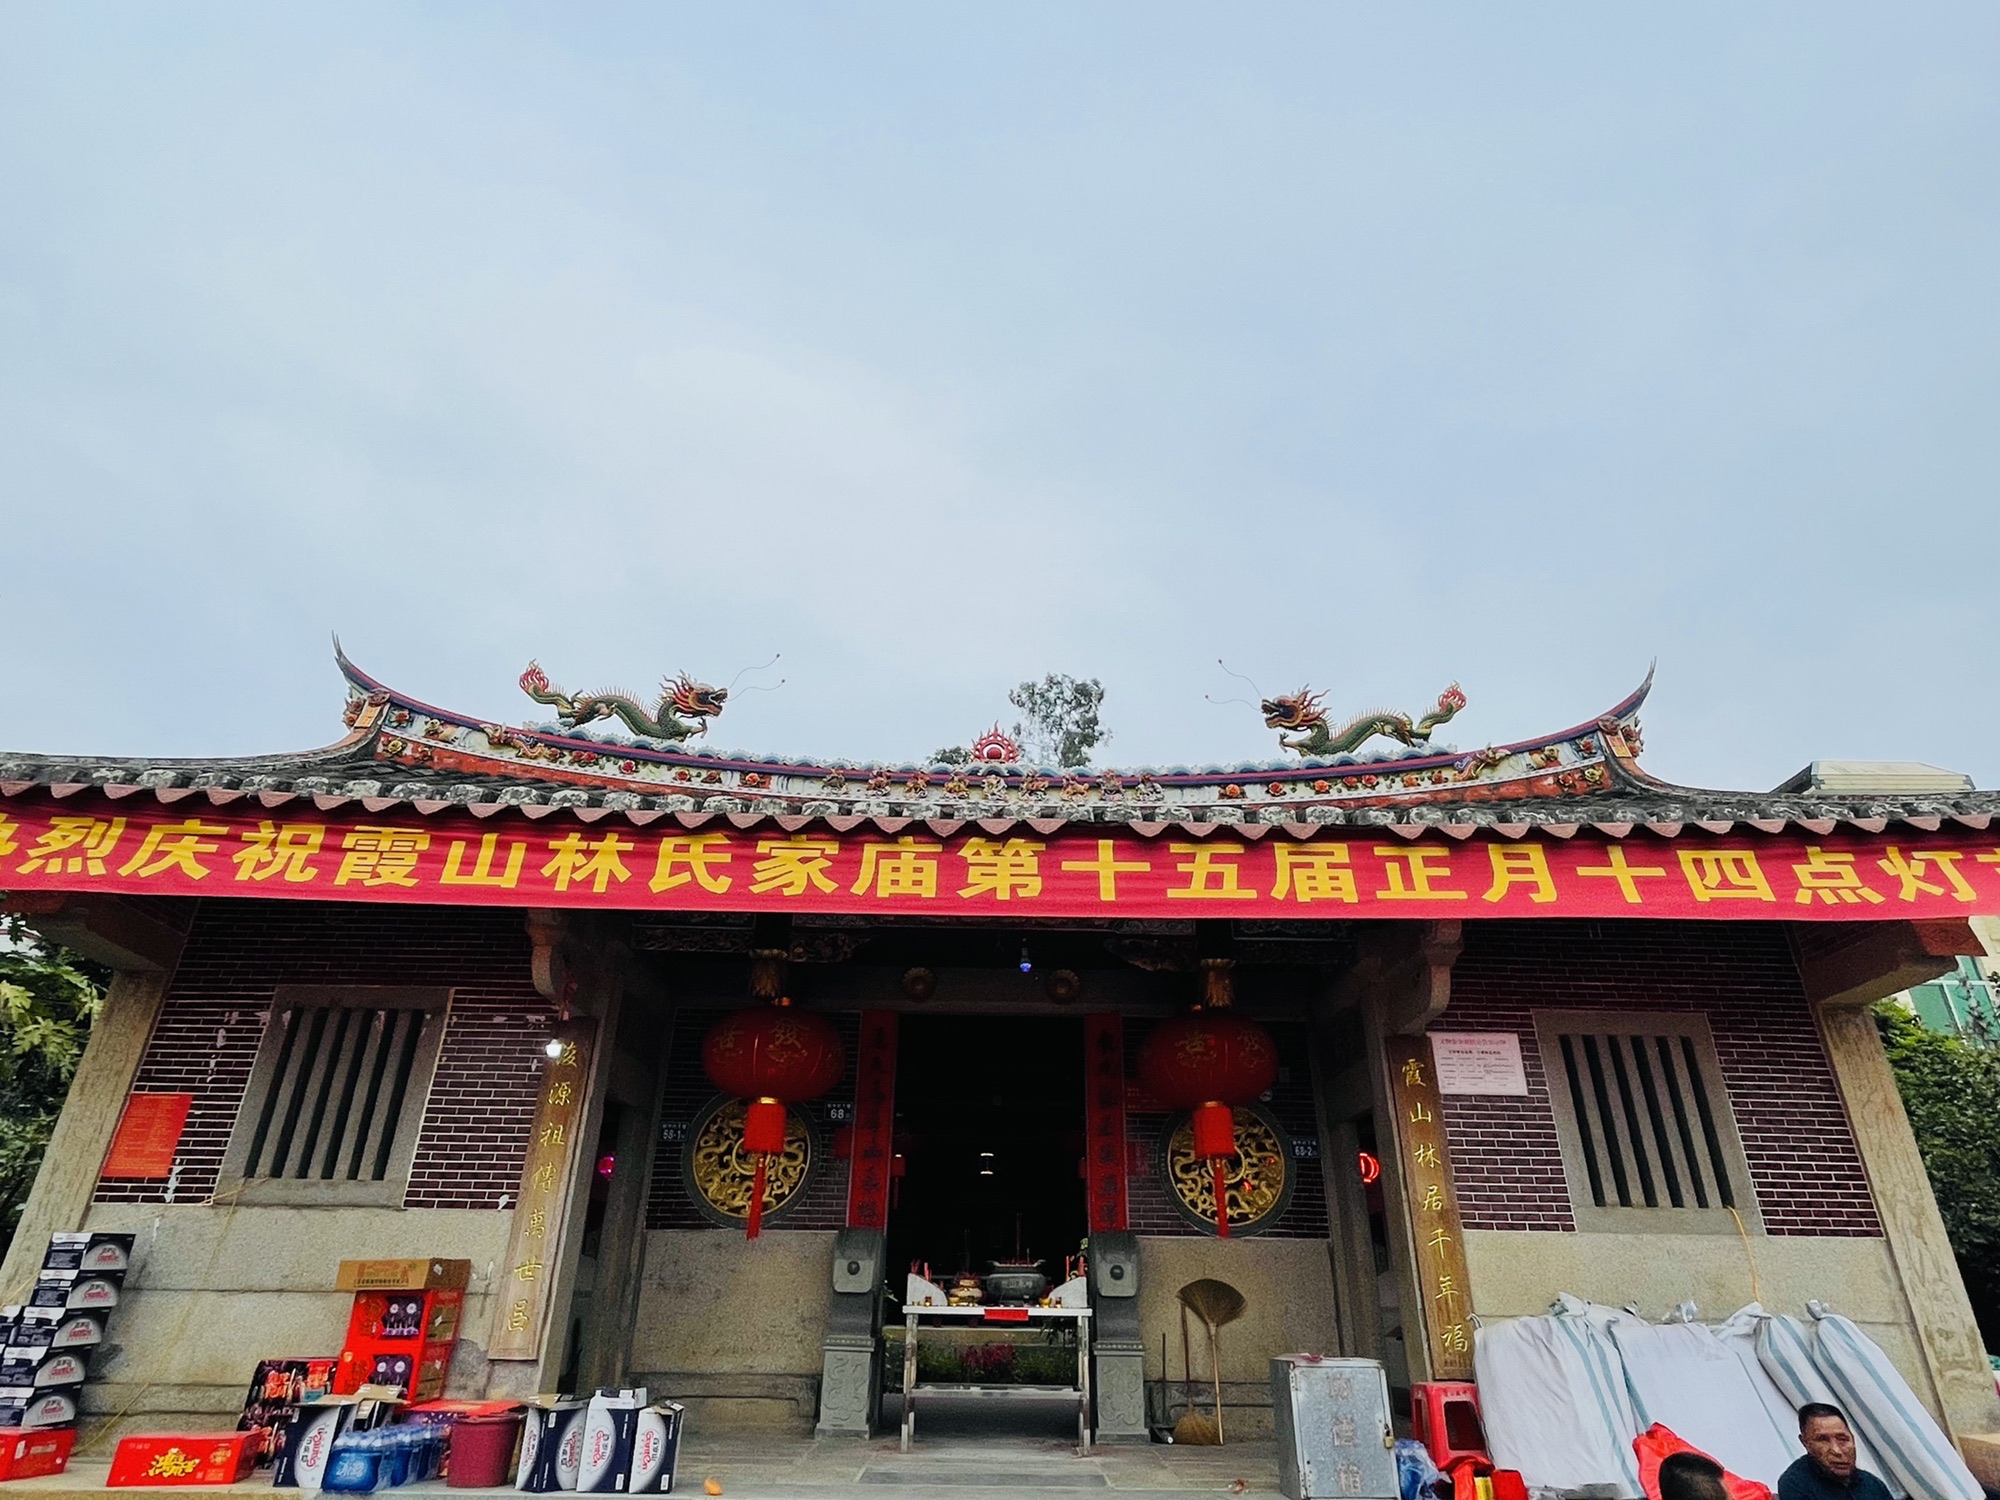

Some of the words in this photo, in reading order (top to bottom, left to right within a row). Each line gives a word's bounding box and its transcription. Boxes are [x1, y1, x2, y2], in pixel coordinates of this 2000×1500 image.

[0, 812, 2000, 905] 烈庆祝霞山林氏家庙第十五届正月十四点灯
[830, 1108, 845, 1120] 68
[1402, 1057, 1469, 1353] 霞山林居千年福
